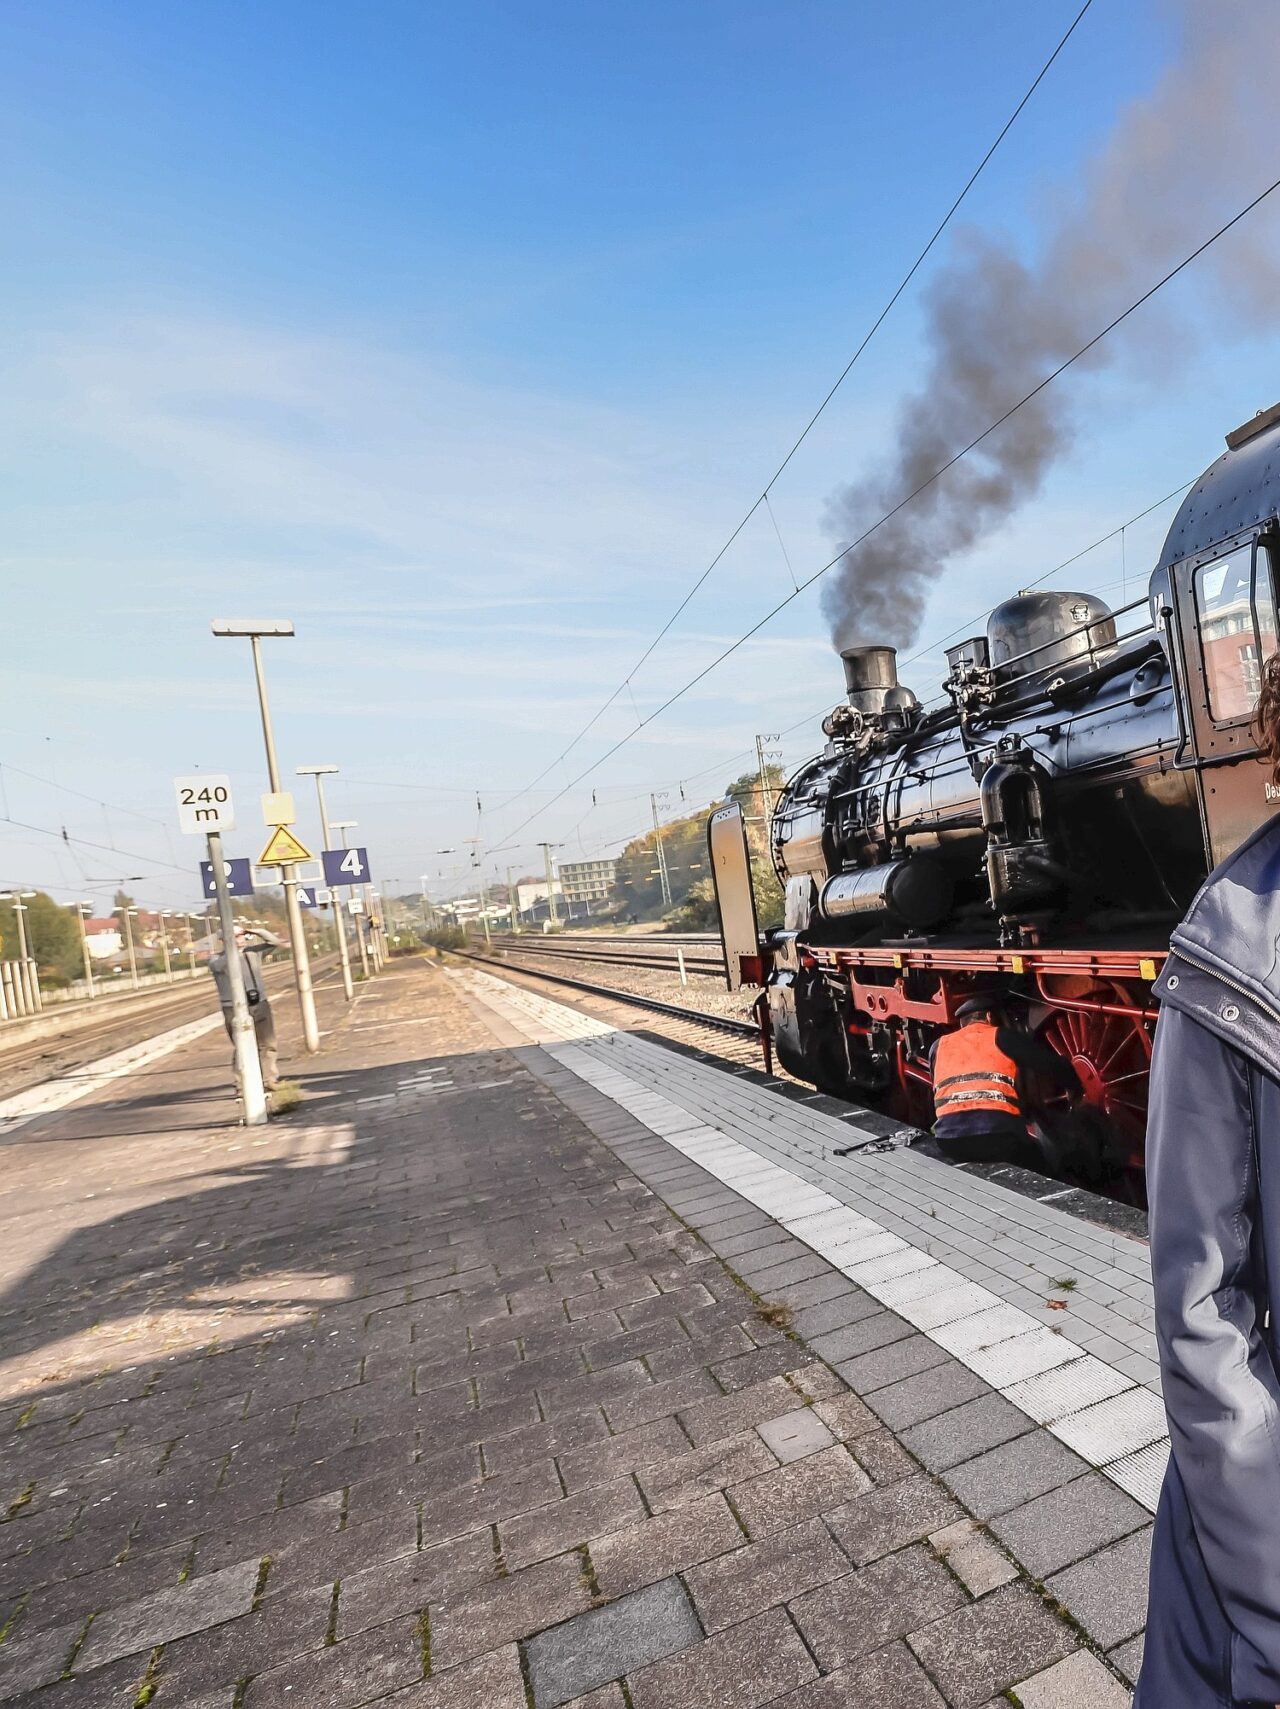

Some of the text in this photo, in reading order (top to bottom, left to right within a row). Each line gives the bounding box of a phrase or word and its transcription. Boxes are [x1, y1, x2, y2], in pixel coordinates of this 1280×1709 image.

[180, 786, 228, 805] 240
[195, 808, 219, 822] m
[340, 849, 364, 876] 4
